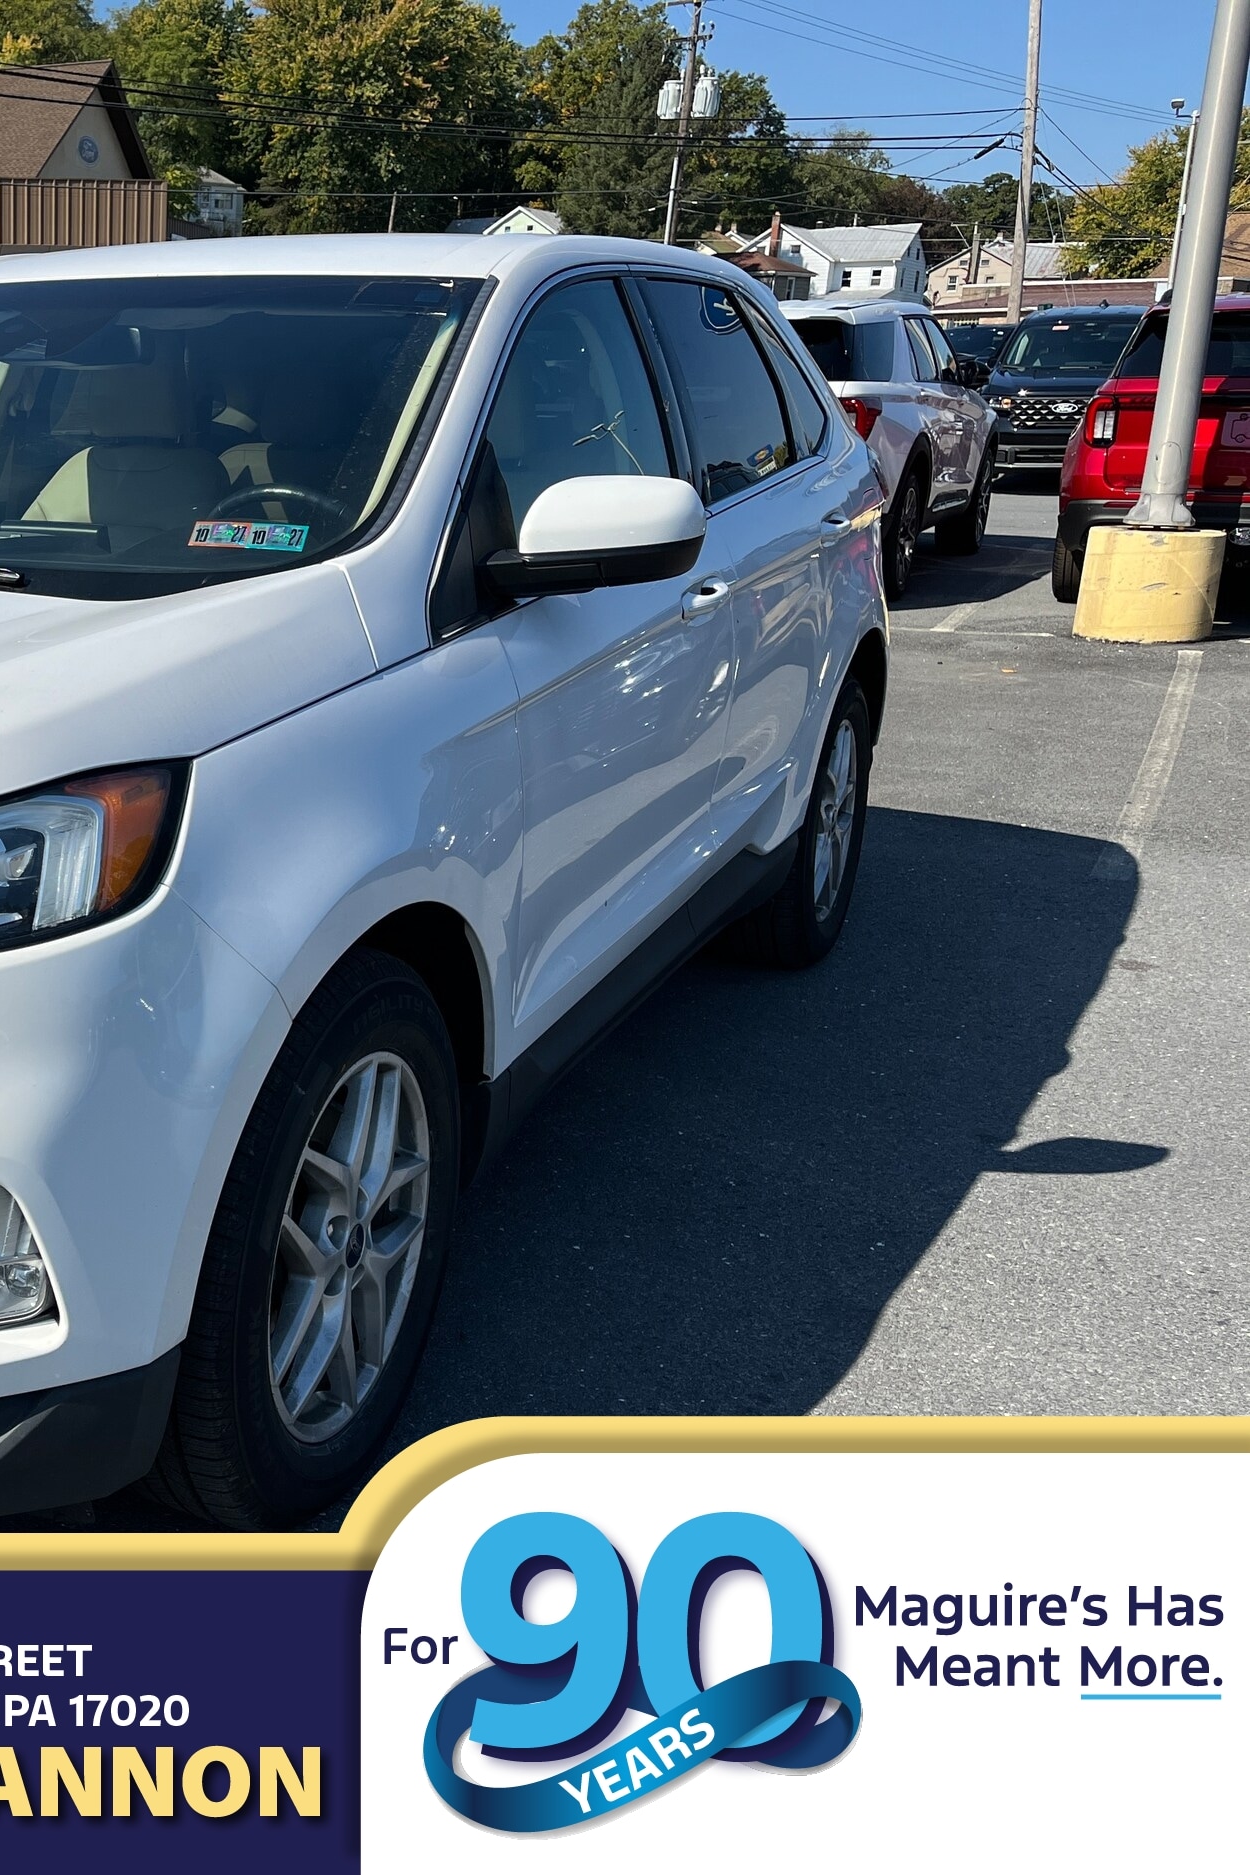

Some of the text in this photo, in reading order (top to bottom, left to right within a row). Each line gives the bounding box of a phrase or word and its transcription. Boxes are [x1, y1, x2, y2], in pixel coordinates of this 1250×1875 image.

[195, 526, 304, 546] 10 27 10 27
